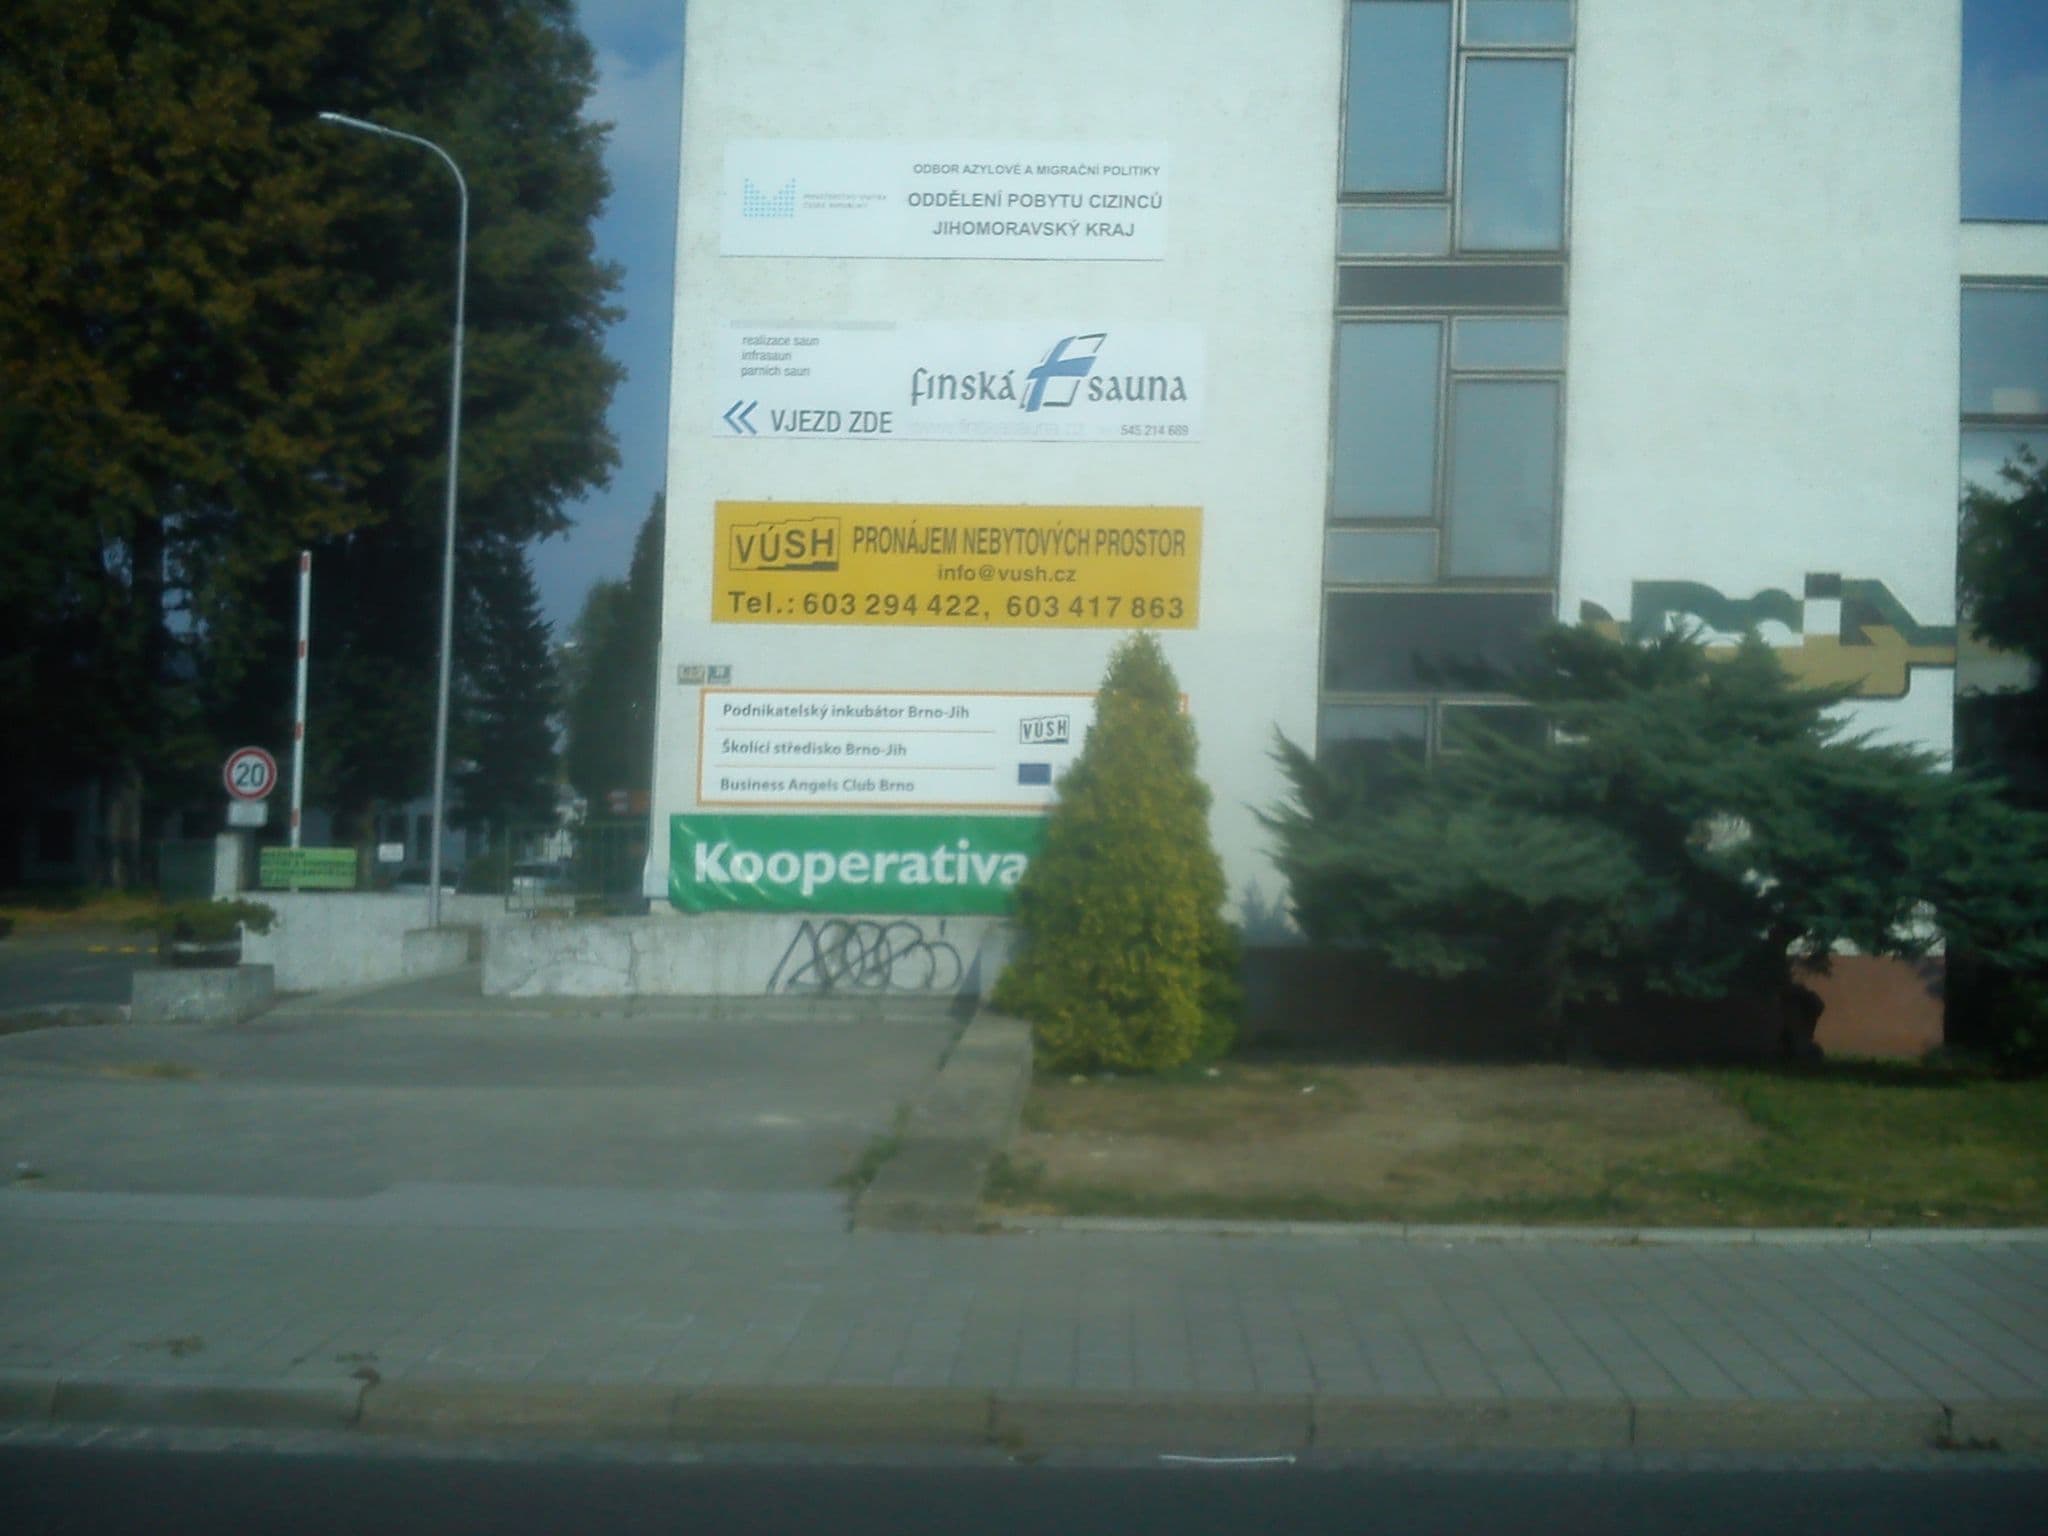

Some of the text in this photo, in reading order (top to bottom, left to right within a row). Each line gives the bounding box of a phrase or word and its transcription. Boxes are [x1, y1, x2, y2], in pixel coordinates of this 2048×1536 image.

[913, 162, 1161, 177] ODBOR AZYLOVÉ A MIGRAČNÍ POLITIKY
[908, 190, 1163, 210] ODDĚLENÍ POBYTU CIZINCŮ
[932, 219, 1135, 238] JIHOMORAVSKÝ KRAJ
[742, 335, 820, 346] realizace saun
[741, 350, 793, 361] infrasaun
[784, 367, 811, 377] saun
[911, 367, 1188, 407] finská sauna
[770, 409, 842, 433] VJEZD
[848, 410, 893, 434] ZDE
[1120, 424, 1142, 436] 545
[1144, 424, 1165, 436] 214
[736, 519, 1186, 564] VÚSH PRONÁJEM NEBYTOVÝCH PROSTOR
[937, 563, 1077, 583] info@vush.cz
[728, 590, 1184, 621] Tel.: 603 294 422, 603 417 863
[723, 703, 970, 719] Podnikatelský inkubátor Brno-Jih
[773, 741, 841, 756] středisko
[845, 743, 907, 757] Brno-Jih
[235, 762, 266, 788] 20
[720, 778, 915, 794] Business Angels Club Brno
[694, 838, 1029, 897] Kooperativa
